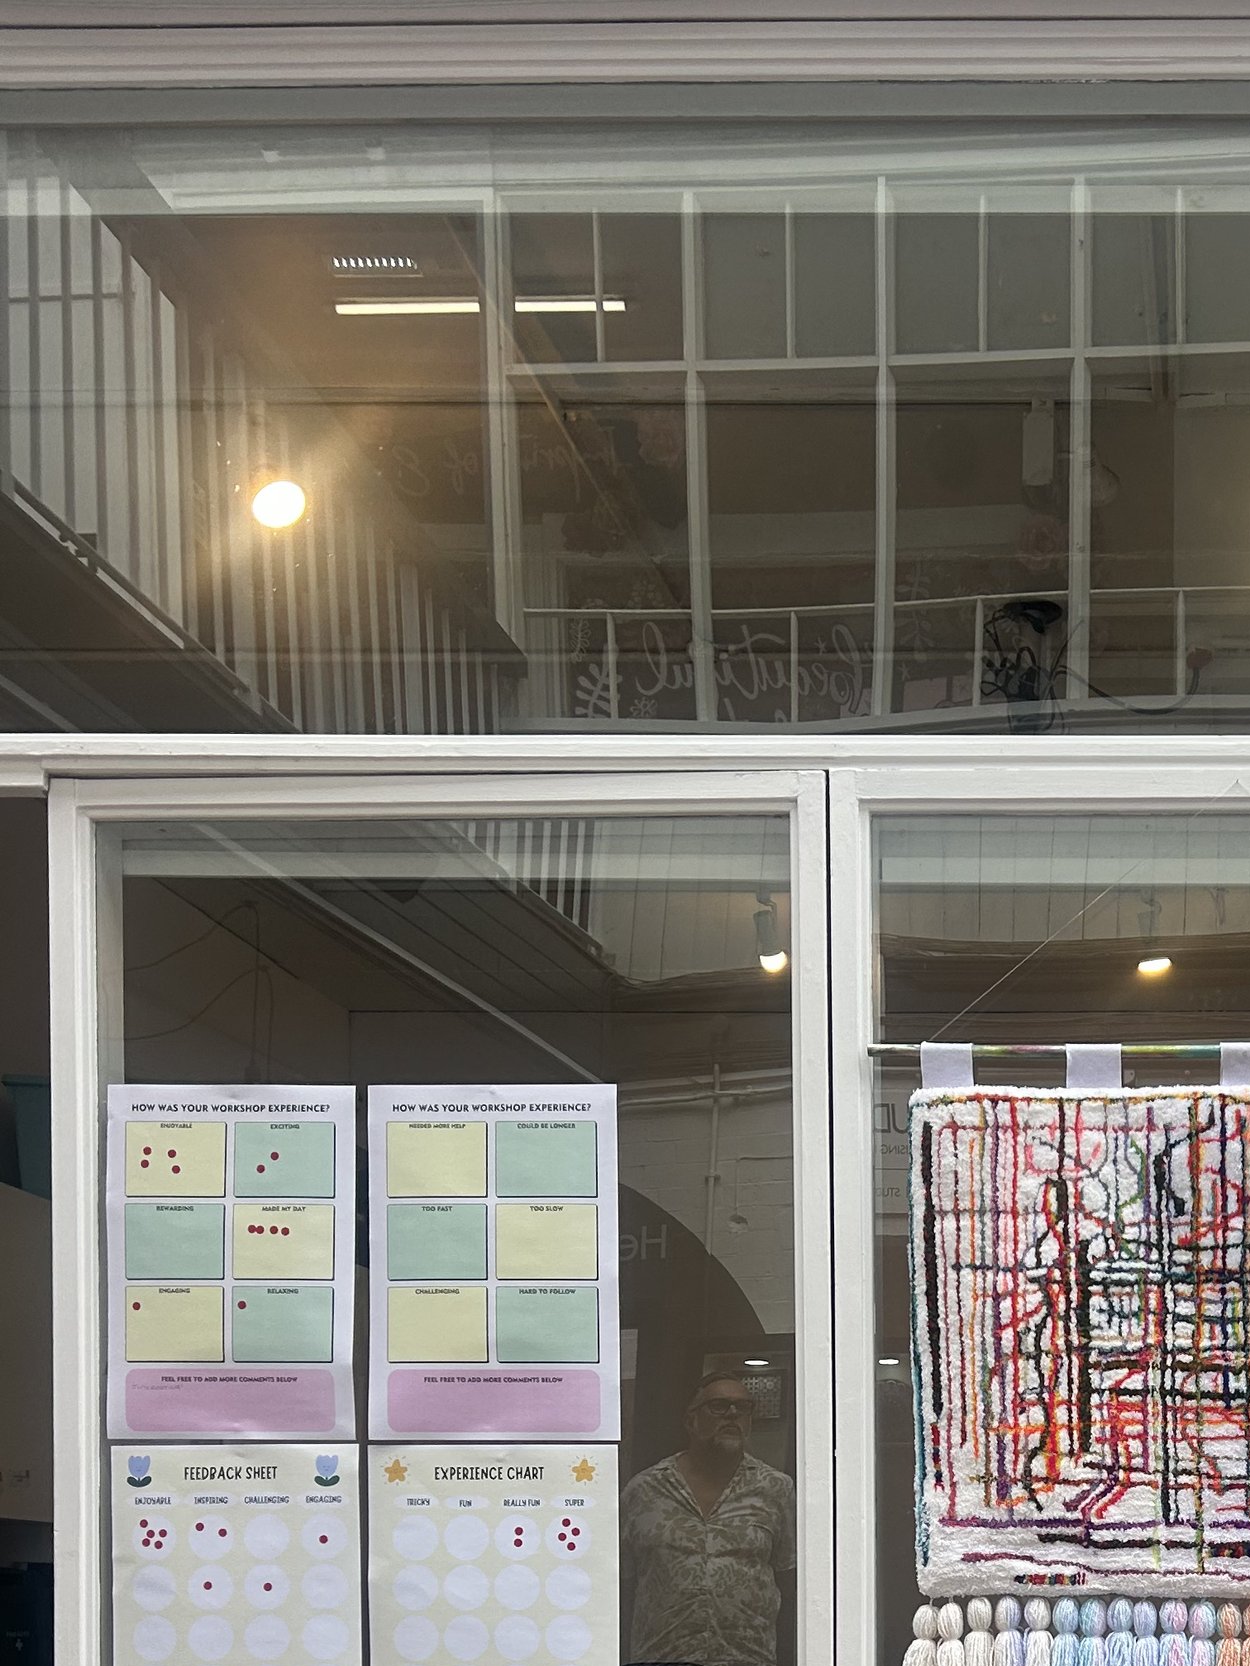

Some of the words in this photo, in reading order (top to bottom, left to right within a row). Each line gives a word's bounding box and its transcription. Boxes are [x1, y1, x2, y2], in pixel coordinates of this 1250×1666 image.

[158, 1104, 178, 1112] WAS
[181, 1104, 208, 1112] YOUR
[211, 1104, 266, 1112] WORKSHOP
[268, 1104, 329, 1112] EXPERIENCE?
[392, 1104, 416, 1112] HOW
[418, 1104, 439, 1112] WAS
[442, 1104, 469, 1112] YOUR
[528, 1103, 591, 1111] EXPERIENCE?
[183, 1466, 242, 1480] FEEDBACK
[245, 1466, 276, 1479] SHEET
[434, 1466, 502, 1480] EXPERIENCE
[506, 1466, 543, 1480] CHART
[194, 1496, 228, 1504] INSPIRING
